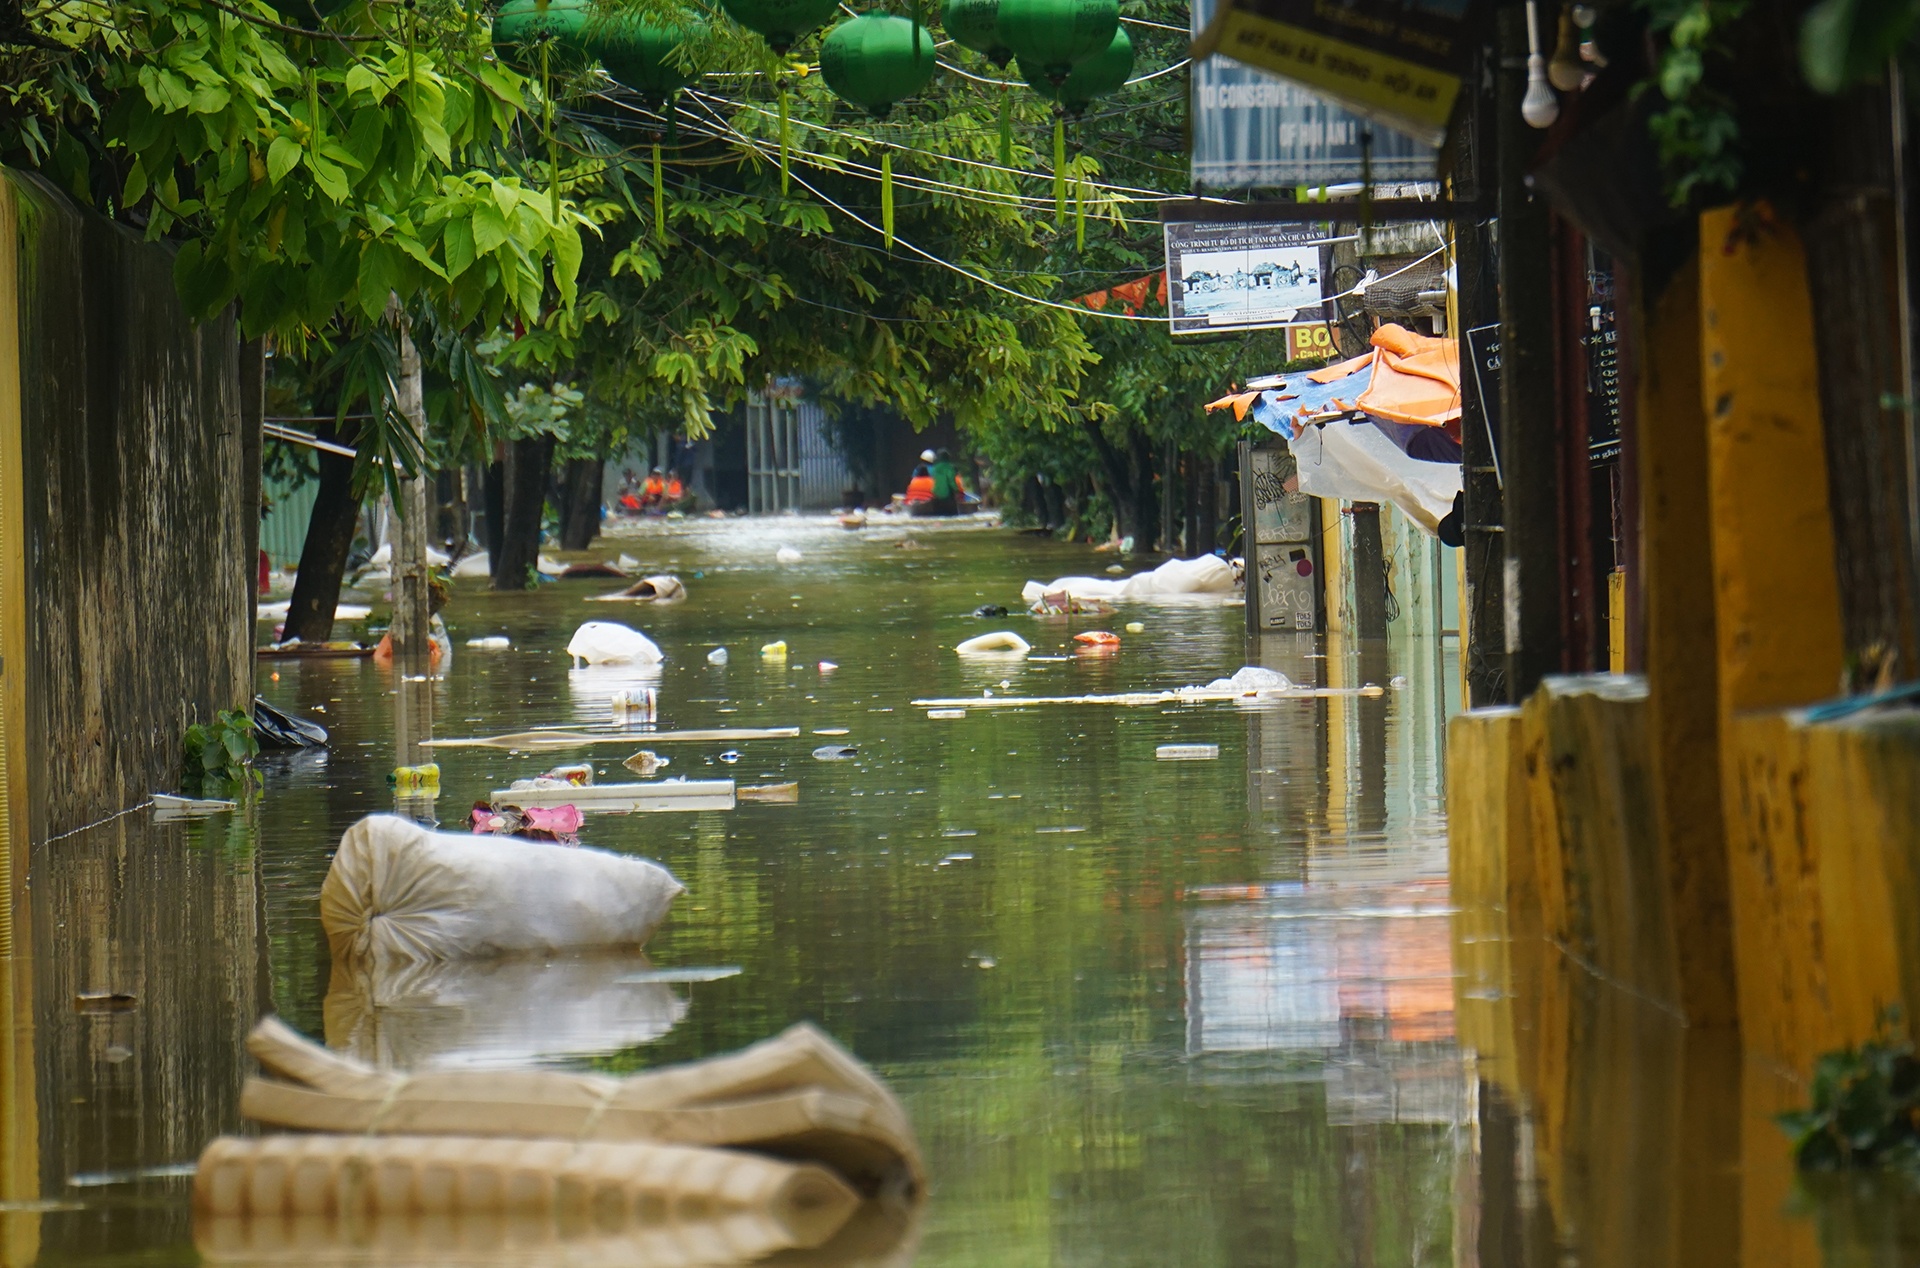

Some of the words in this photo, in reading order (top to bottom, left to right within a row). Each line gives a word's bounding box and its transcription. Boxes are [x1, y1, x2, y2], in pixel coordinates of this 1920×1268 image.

[1218, 82, 1289, 108] CONSERVE
[1170, 240, 1189, 249] CÔNG
[1190, 239, 1210, 249] TRÌNH
